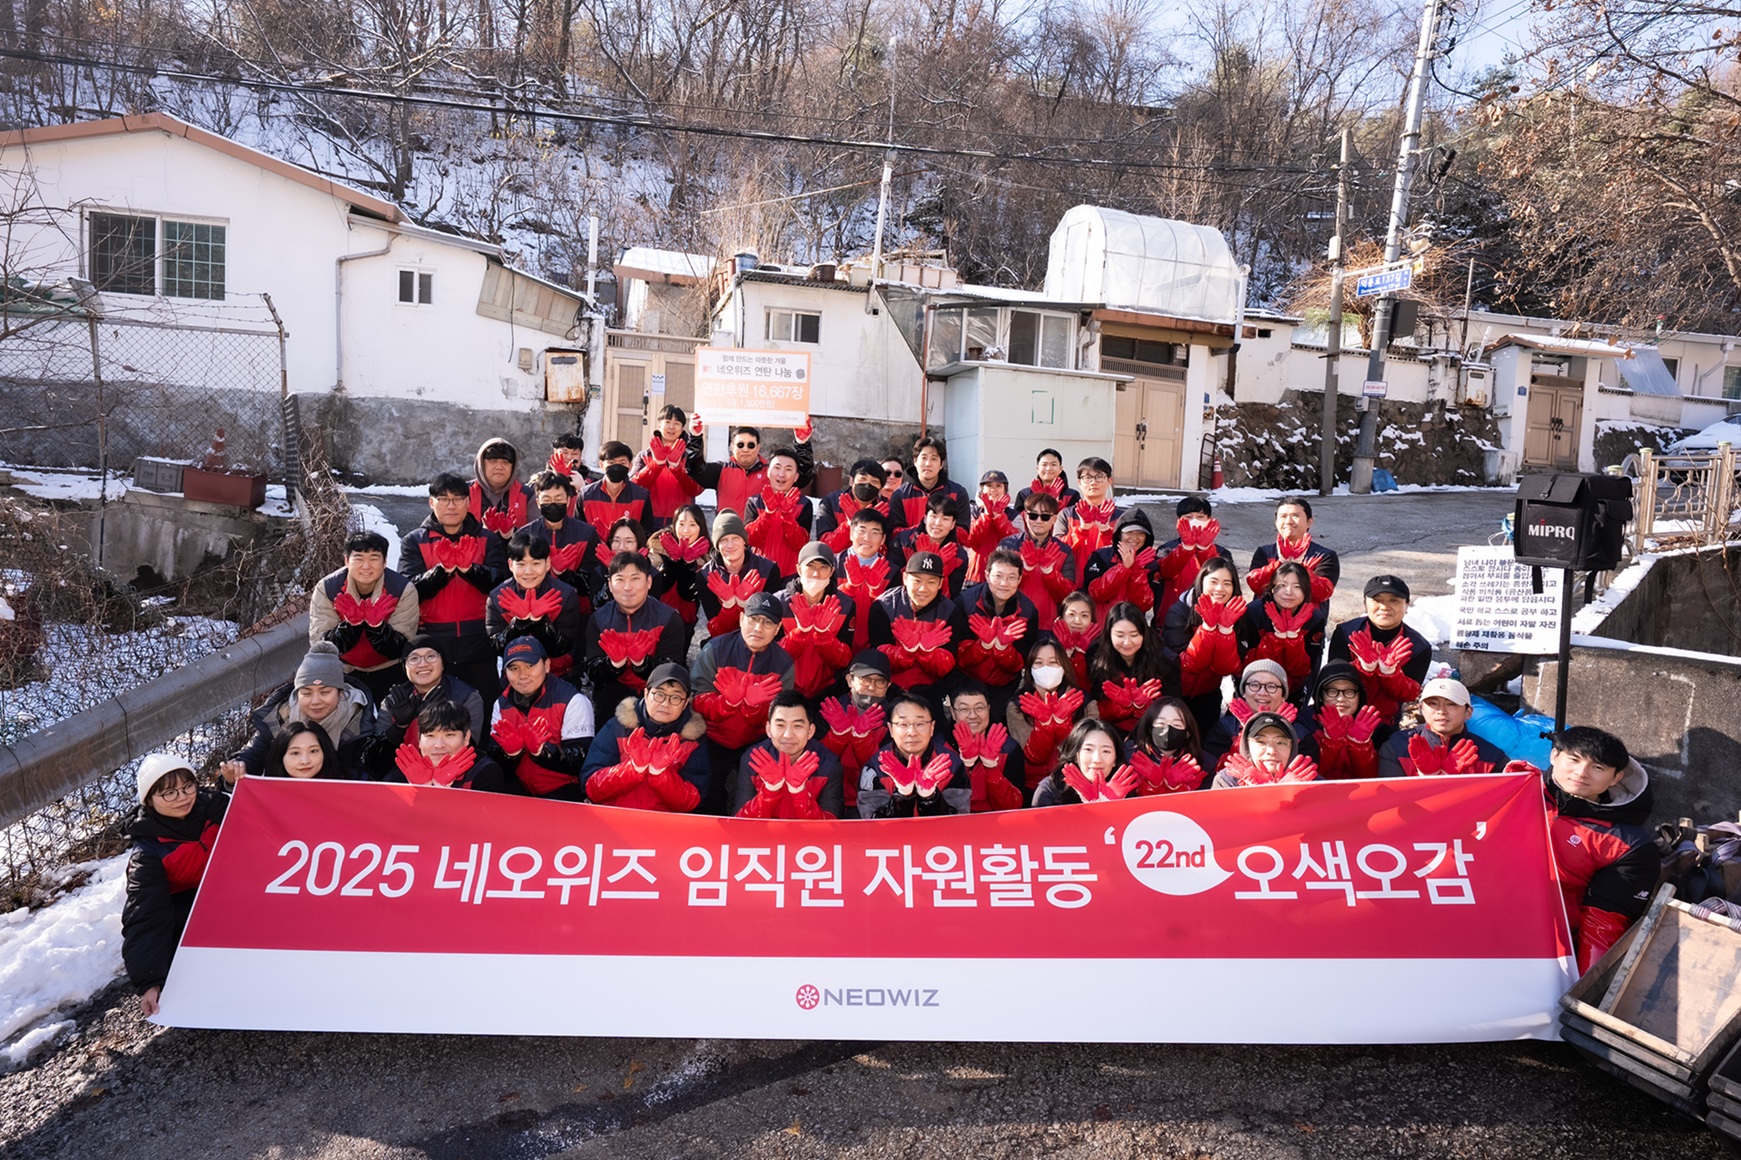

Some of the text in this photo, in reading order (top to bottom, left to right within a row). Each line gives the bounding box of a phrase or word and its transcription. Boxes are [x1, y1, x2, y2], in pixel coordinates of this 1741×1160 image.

[722, 354, 787, 365] 함께 만드는 따뜻한 겨울
[716, 365, 793, 378] 네오위즈 연탄 나눔
[702, 382, 804, 400] 연탄후원 16,667장
[1481, 559, 1497, 567] 나이
[1461, 580, 1477, 588] 소각
[1494, 607, 1518, 615] 스스로
[1540, 608, 1557, 616] 하고
[1457, 618, 1473, 626] 서로
[1493, 619, 1517, 627] 어린이
[1481, 630, 1506, 639] 재활용
[1473, 642, 1489, 650] 주의
[265, 840, 420, 898] 2025
[434, 843, 660, 907] 네오위즈
[679, 845, 845, 909] 임직원
[863, 844, 1099, 909] 자원활동
[824, 988, 940, 1007] NEOWIZ
